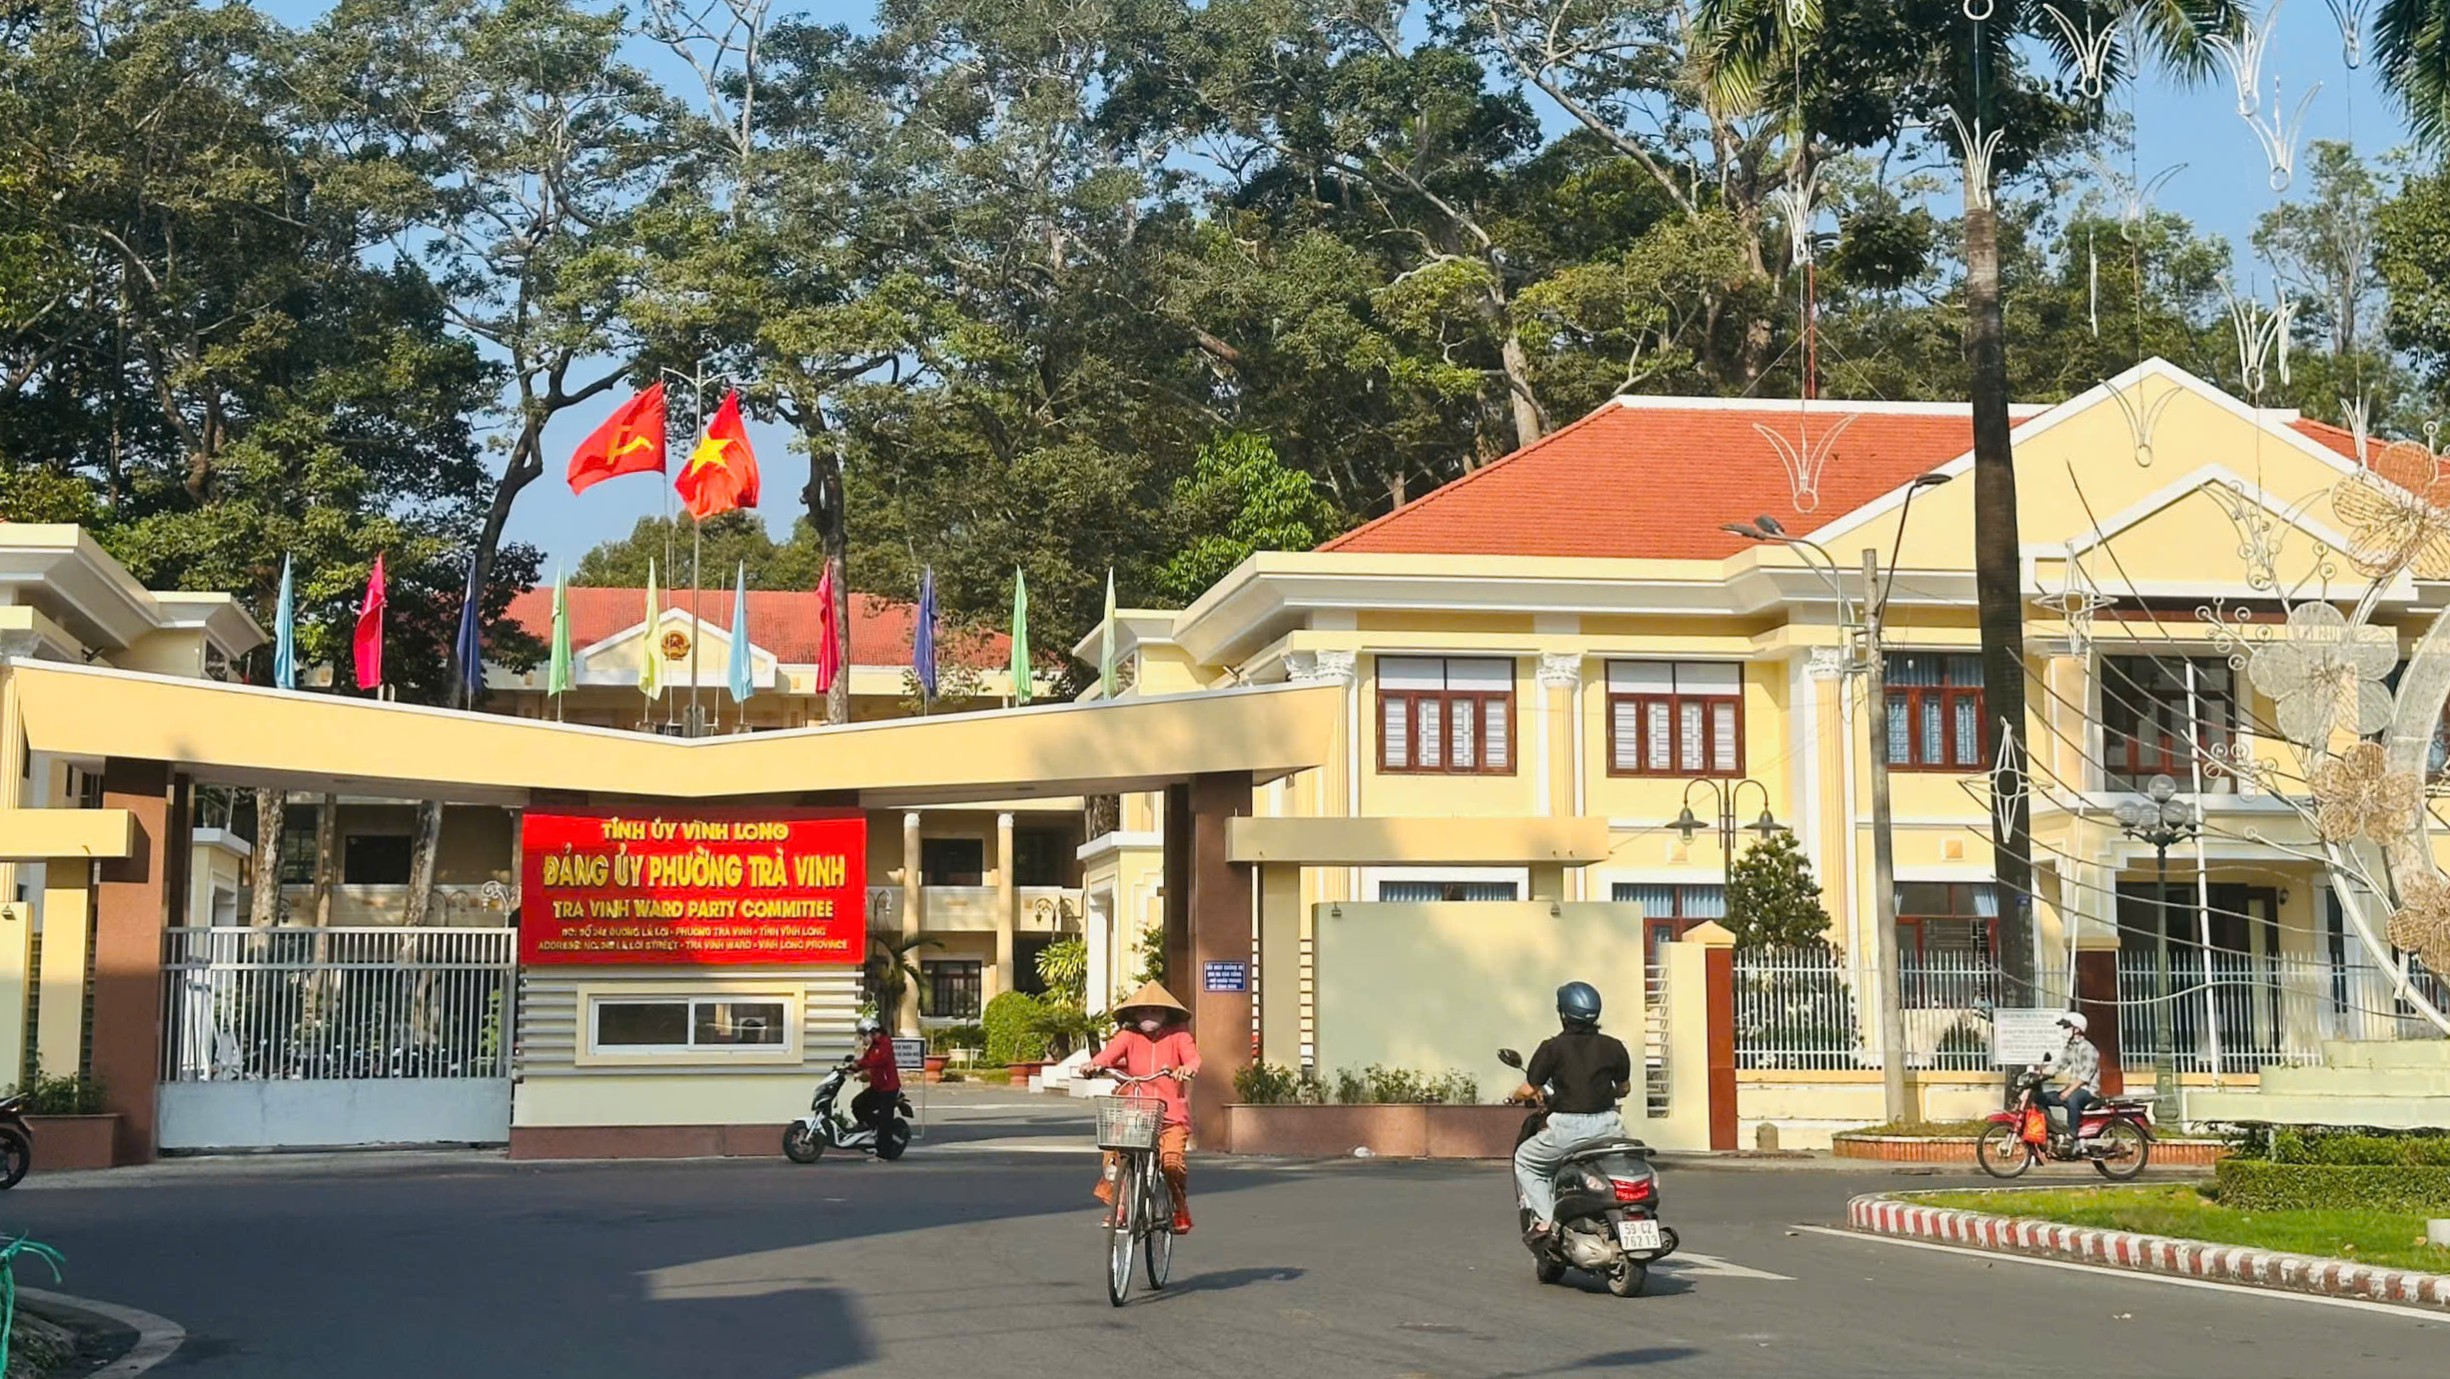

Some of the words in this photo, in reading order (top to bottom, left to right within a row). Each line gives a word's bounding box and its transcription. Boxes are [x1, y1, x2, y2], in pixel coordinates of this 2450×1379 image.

[601, 816, 645, 840] TỈNH
[650, 816, 678, 840] ỦY
[733, 822, 790, 841] LONG
[543, 842, 609, 887] ĐẢNG
[614, 842, 645, 887] ỦY
[648, 844, 743, 887] PHƯỜNG
[748, 845, 788, 887] TRÀ
[794, 854, 846, 887] VINH
[552, 900, 584, 918] TRA
[589, 898, 630, 918] VINH
[633, 899, 684, 918] WARD
[688, 899, 737, 918] PARTY
[741, 899, 834, 918] COMMITTEE
[802, 926, 826, 937] LONG
[703, 939, 725, 950] VINH
[726, 939, 751, 950] WARD
[758, 939, 779, 950] VINH
[780, 939, 804, 950] LONG
[805, 939, 847, 950] PROVINCE
